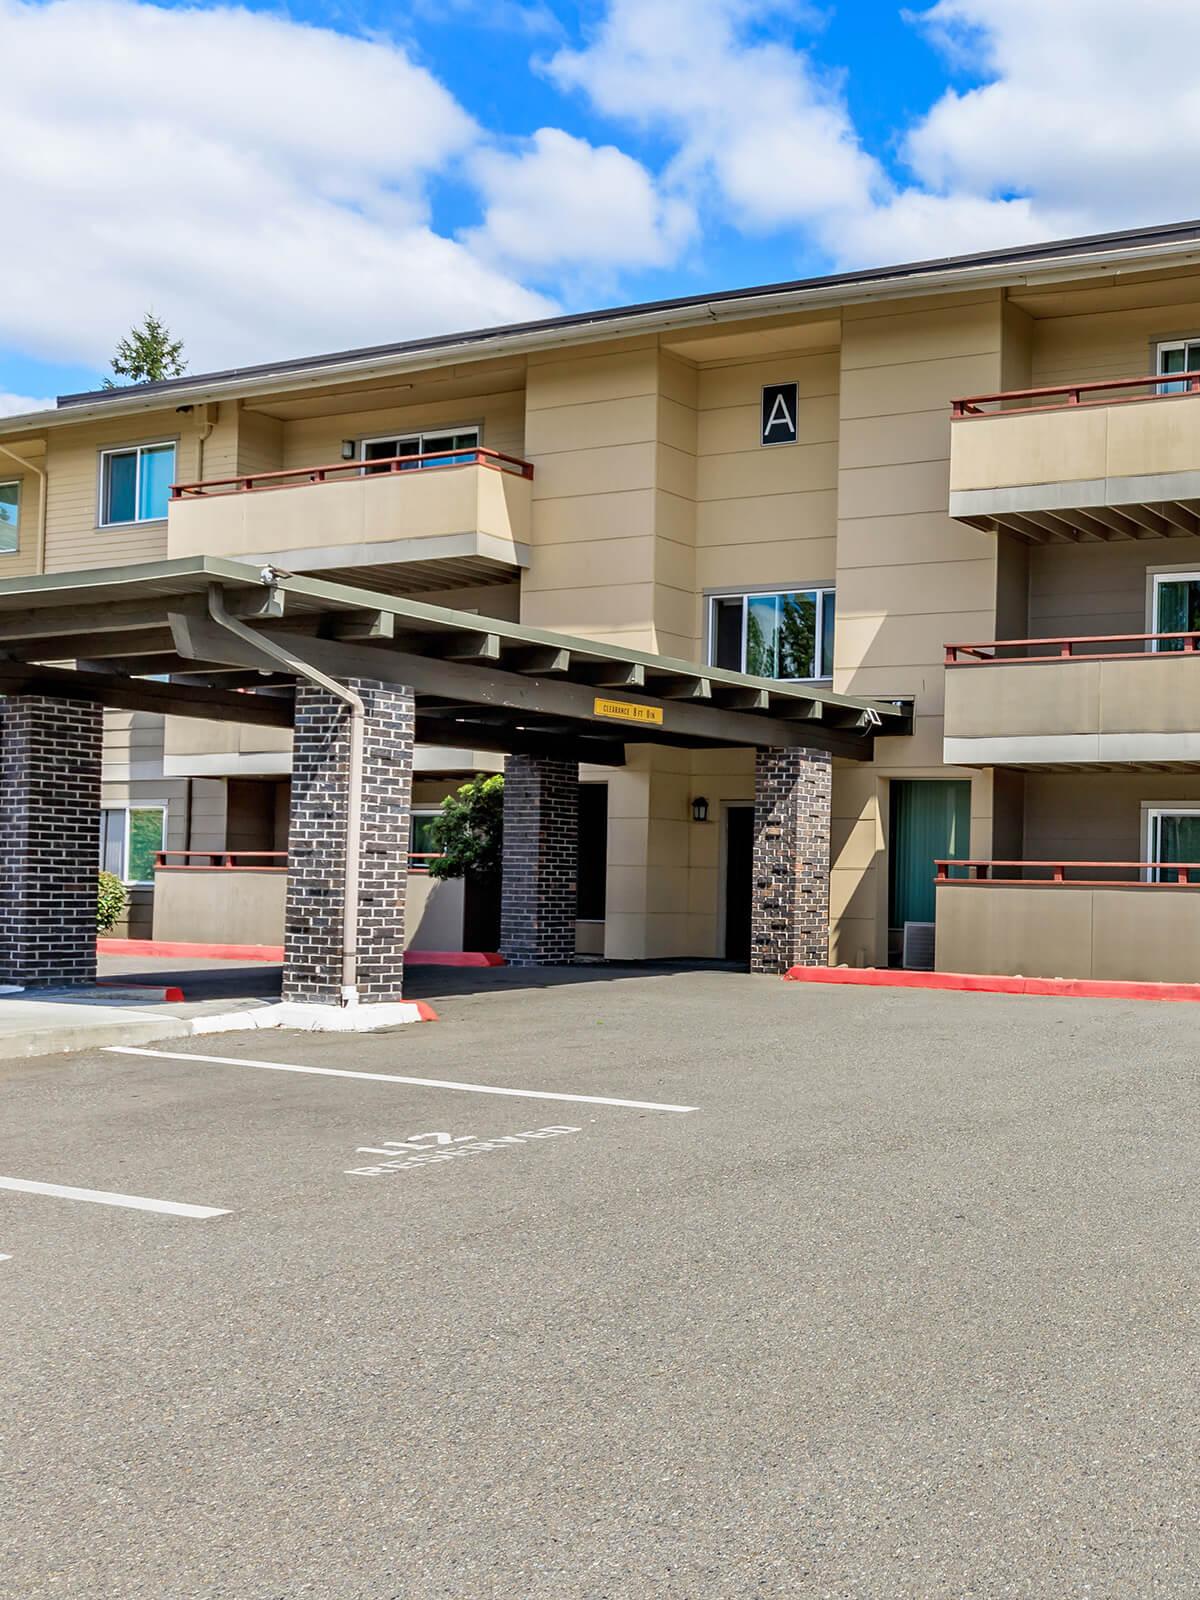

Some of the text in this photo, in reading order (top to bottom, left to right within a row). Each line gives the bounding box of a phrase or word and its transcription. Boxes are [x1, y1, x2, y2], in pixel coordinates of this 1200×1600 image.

[763, 393, 795, 436] A
[603, 704, 630, 716] CLEARANCE
[343, 1125, 583, 1176] RESERVED
[354, 1131, 479, 1156] 112
